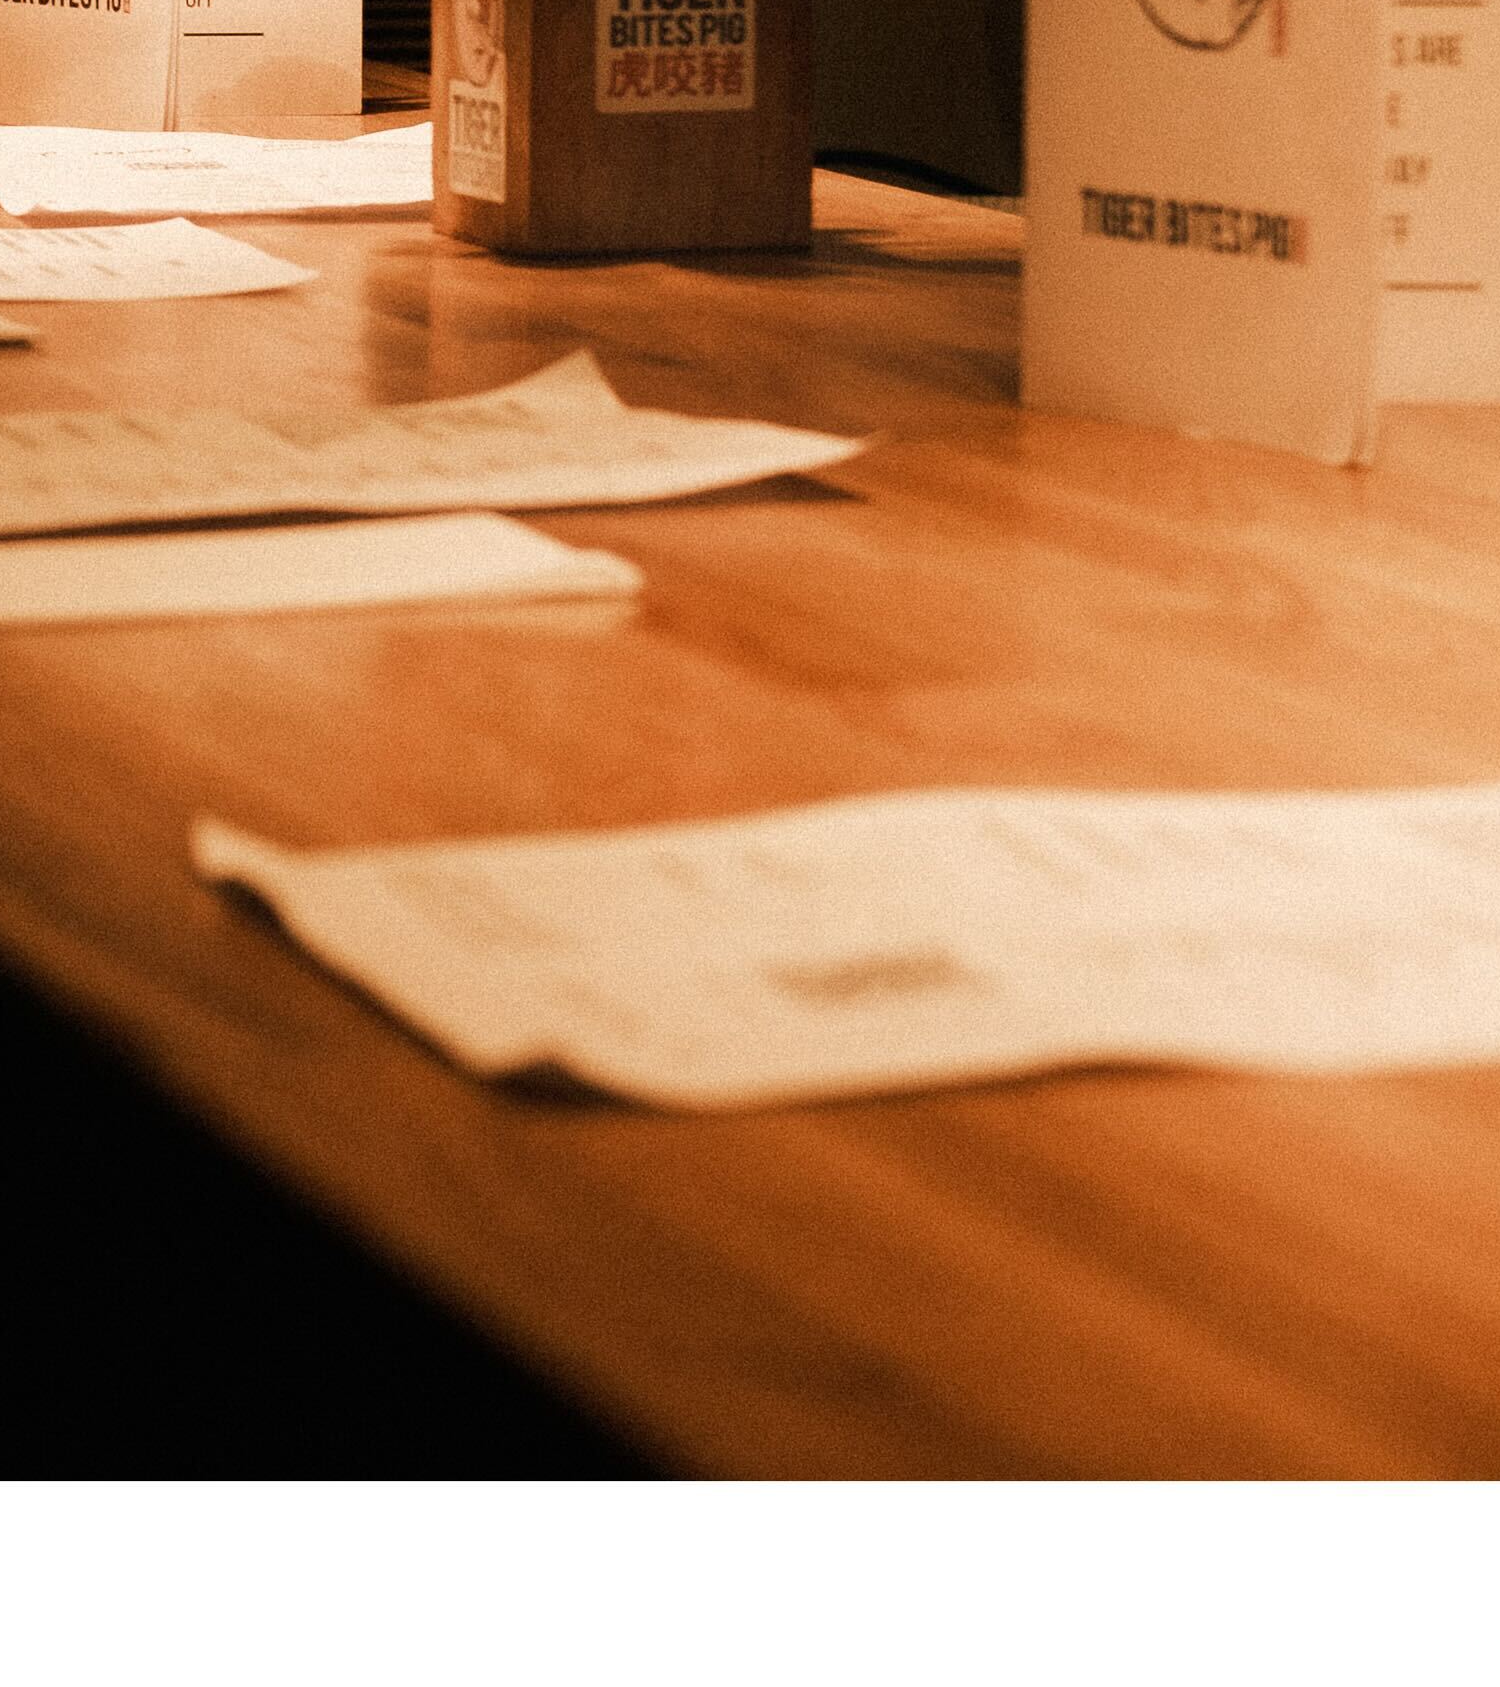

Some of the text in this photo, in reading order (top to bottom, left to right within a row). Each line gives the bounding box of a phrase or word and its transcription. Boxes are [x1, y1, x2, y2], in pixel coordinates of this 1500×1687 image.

[610, 12, 747, 49] BITES PIG
[1080, 186, 1155, 243] TIGER
